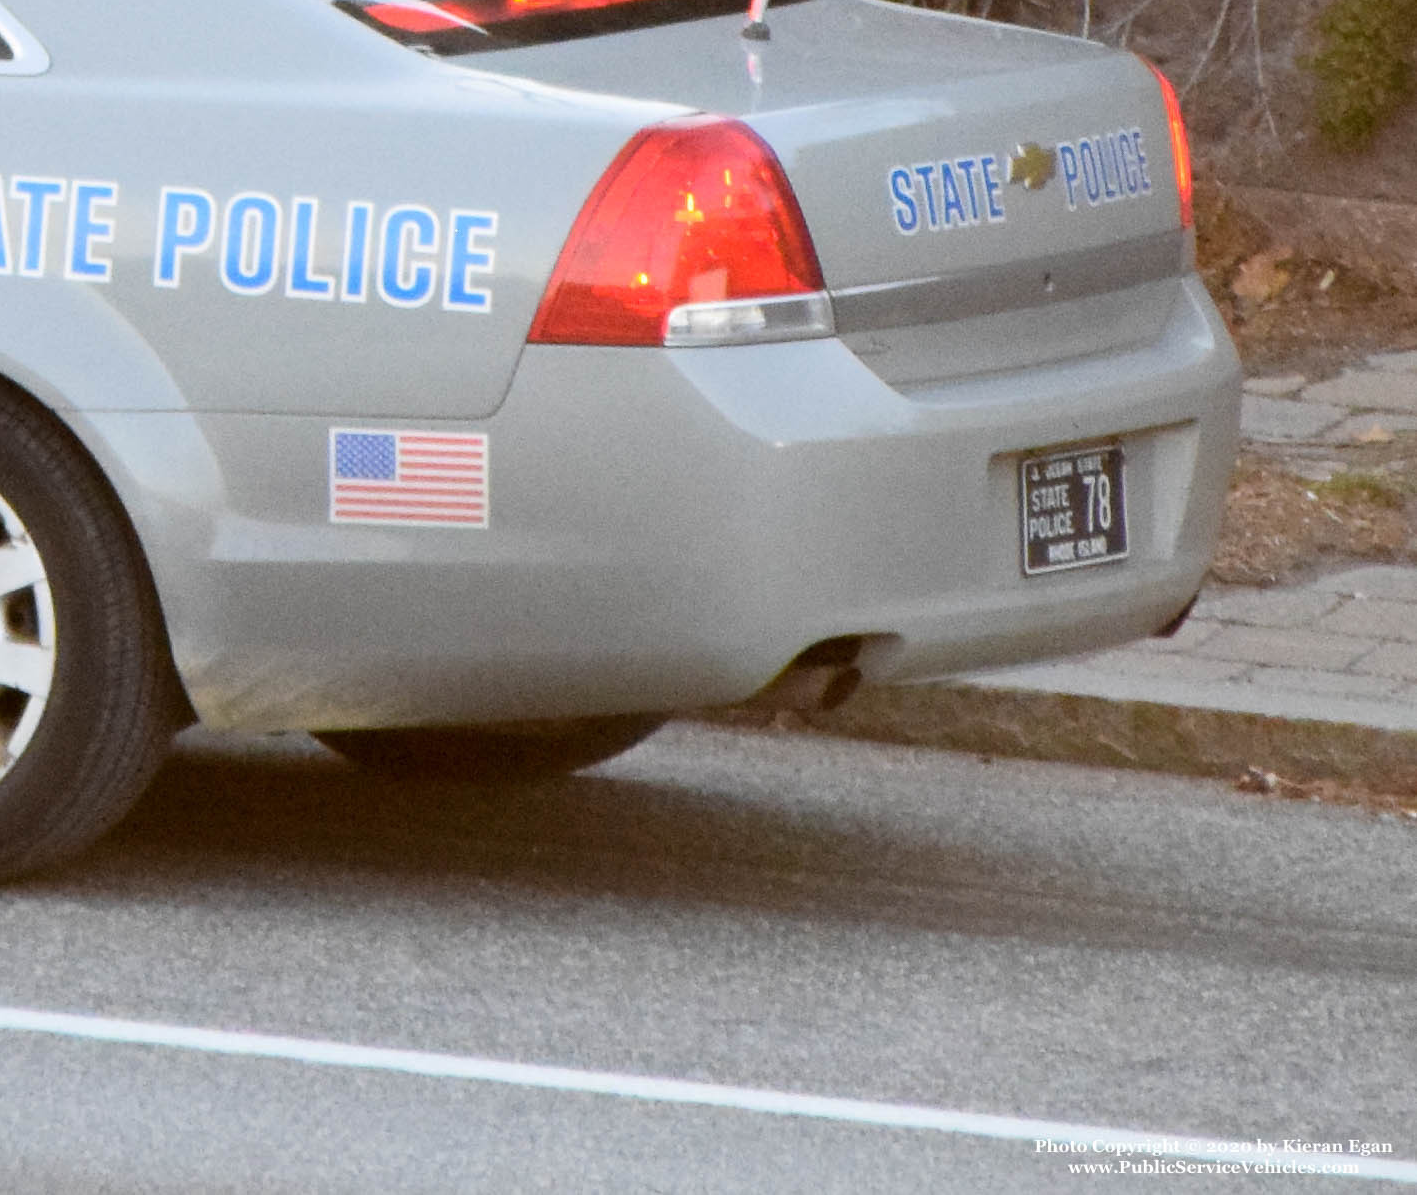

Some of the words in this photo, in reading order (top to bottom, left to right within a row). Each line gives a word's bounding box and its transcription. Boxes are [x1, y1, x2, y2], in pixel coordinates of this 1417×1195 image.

[889, 153, 1004, 235] STATE
[1057, 127, 1151, 212] POLICE
[154, 185, 498, 311] POLICE
[1029, 511, 1074, 540] POLICE
[1031, 485, 1070, 512] STATE
[1083, 473, 1111, 533] 78
